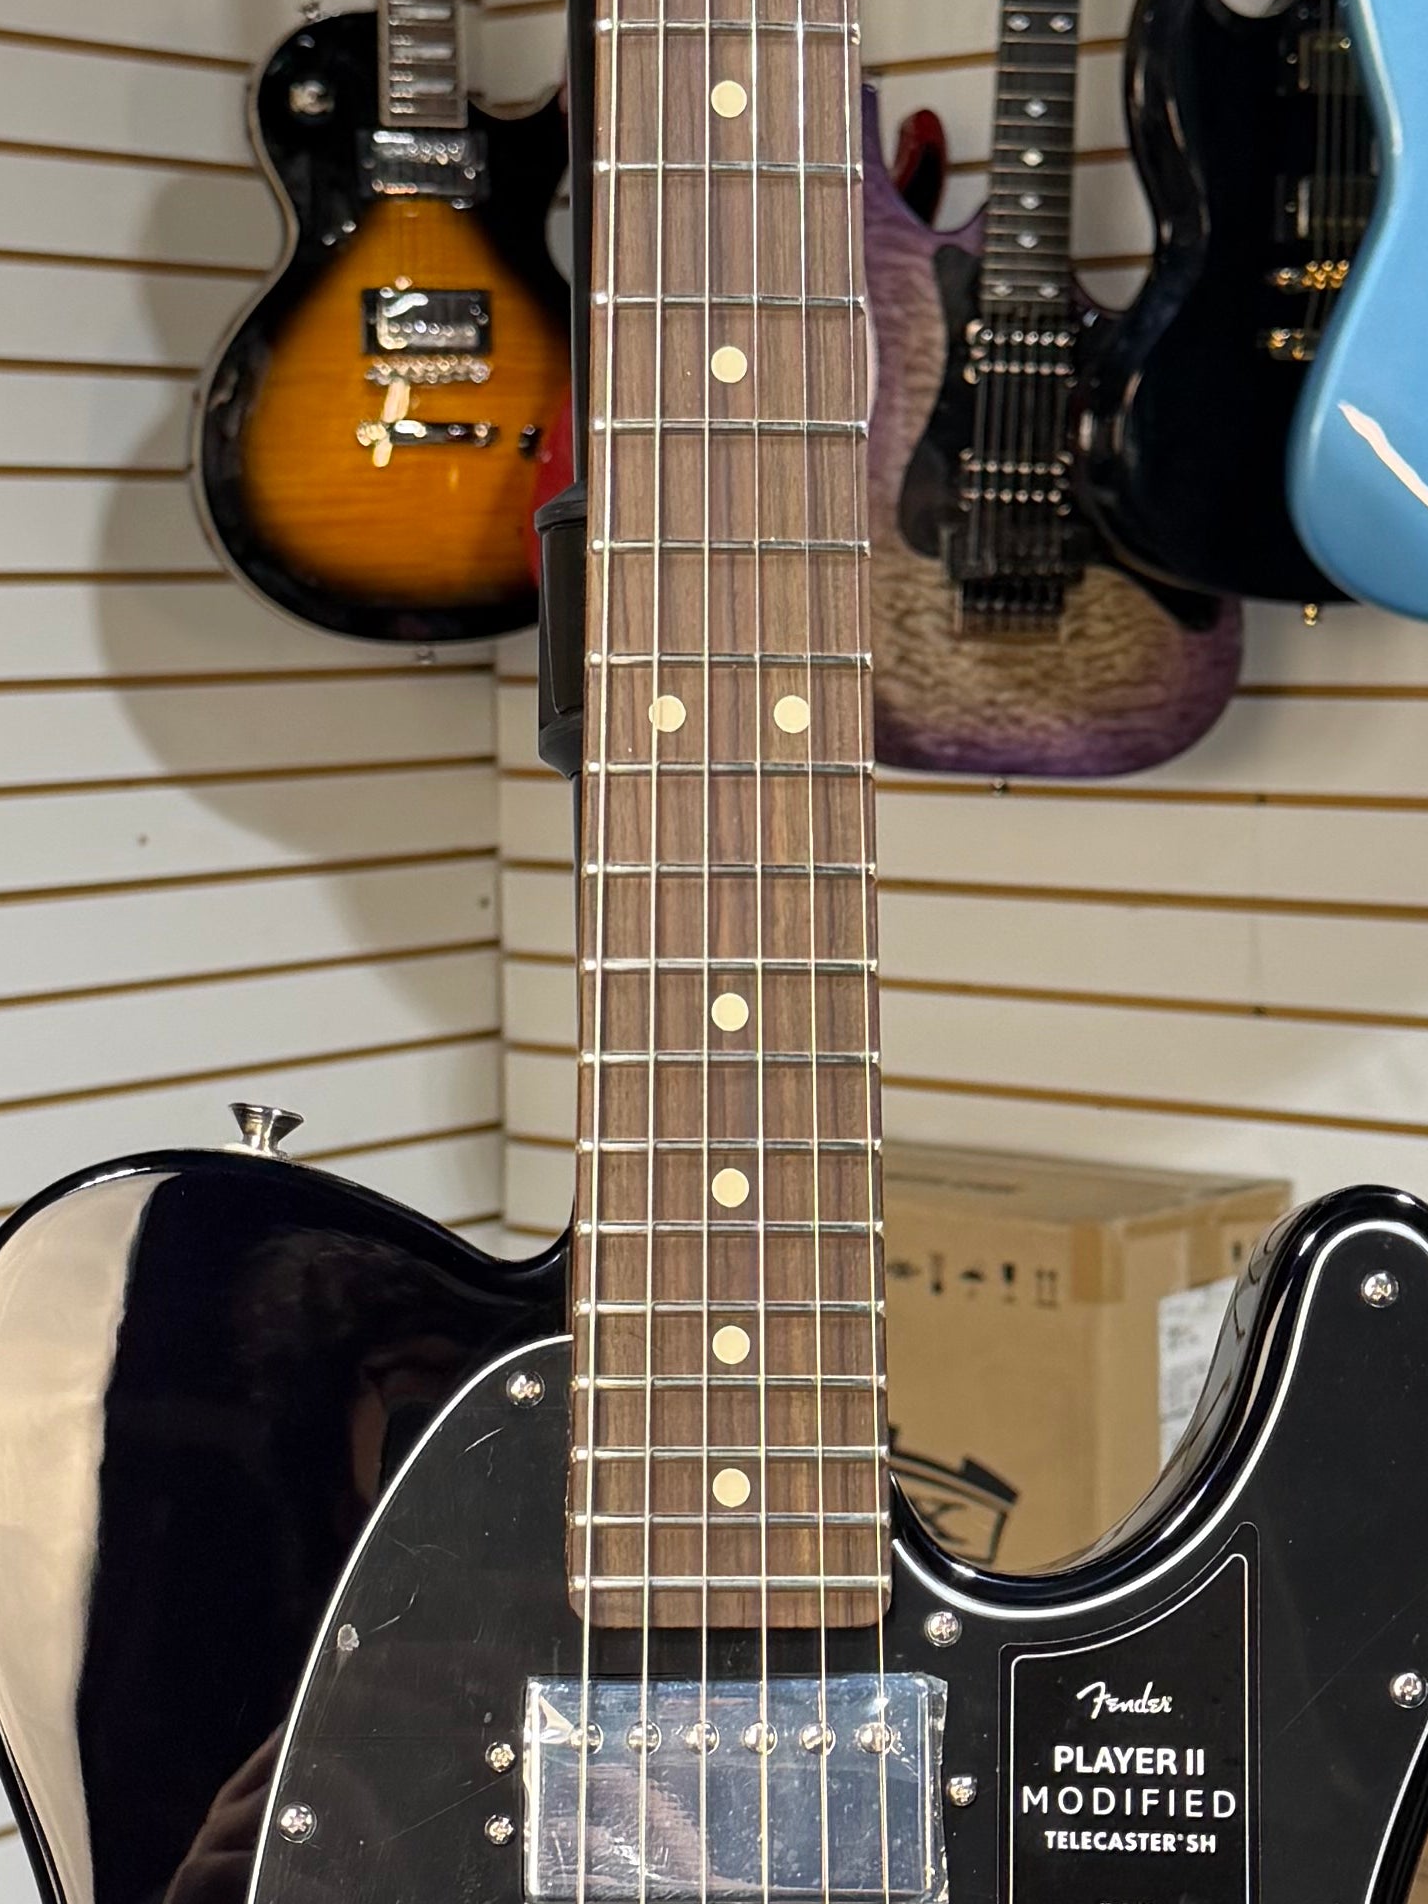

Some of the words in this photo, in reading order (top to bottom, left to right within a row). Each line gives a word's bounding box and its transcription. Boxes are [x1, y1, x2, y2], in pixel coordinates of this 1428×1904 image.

[1075, 1680, 1174, 1720] Fender
[1052, 1745, 1178, 1776] PLAYER
[1184, 1748, 1206, 1777] II
[1022, 1785, 1238, 1820] MODIFIED
[1186, 1834, 1217, 1855] SH
